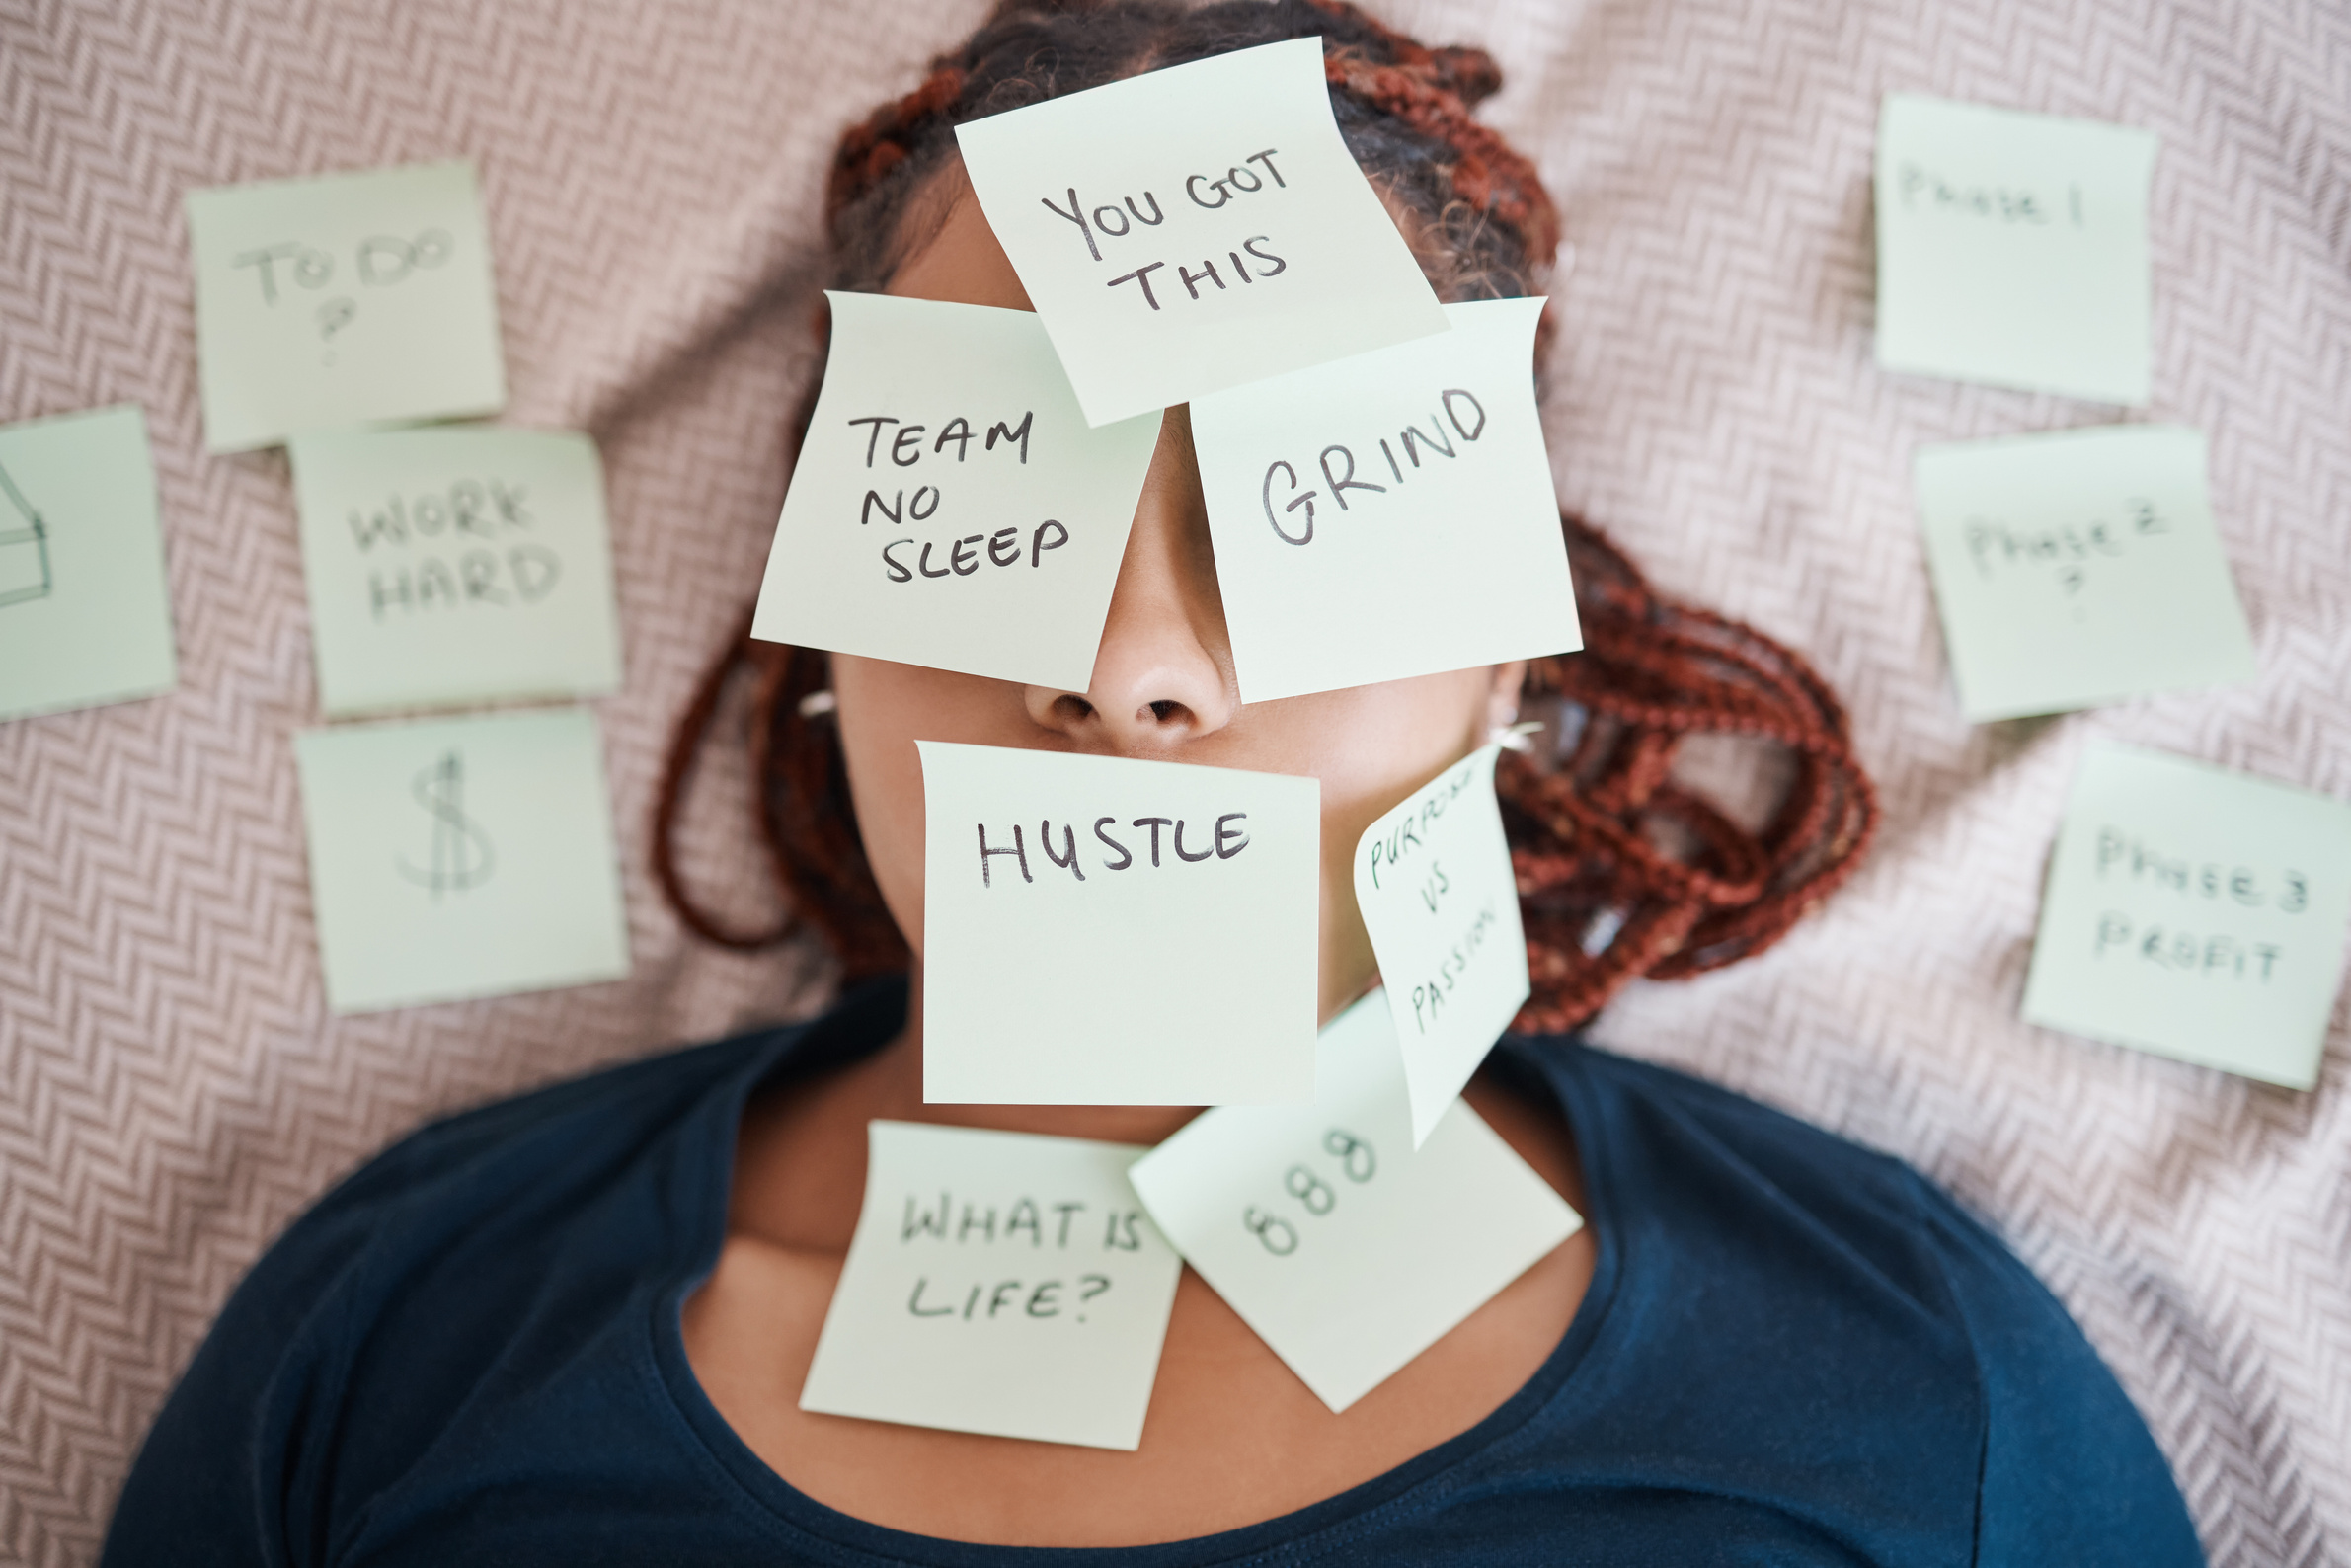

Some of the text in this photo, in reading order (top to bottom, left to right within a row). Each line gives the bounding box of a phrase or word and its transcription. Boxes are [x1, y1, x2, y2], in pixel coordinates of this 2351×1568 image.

[1041, 147, 1289, 262] YOU GOT
[229, 225, 458, 306] TO DO
[1106, 234, 1288, 312] THIS
[314, 296, 358, 368] ?
[847, 410, 1034, 468] TEAM
[1261, 388, 1488, 547] GRIND
[346, 476, 535, 555] WORK
[860, 484, 941, 526] NO
[2121, 495, 2175, 538] 2
[365, 543, 564, 624] HARD
[881, 518, 1070, 585] SLEEP
[395, 746, 497, 903] $
[977, 812, 1252, 889] HUSTLE
[1419, 859, 1450, 914] VS
[2275, 866, 2312, 916] 3
[900, 1191, 1143, 1252] WHAT IS
[907, 1274, 1113, 1324] LIFE?
